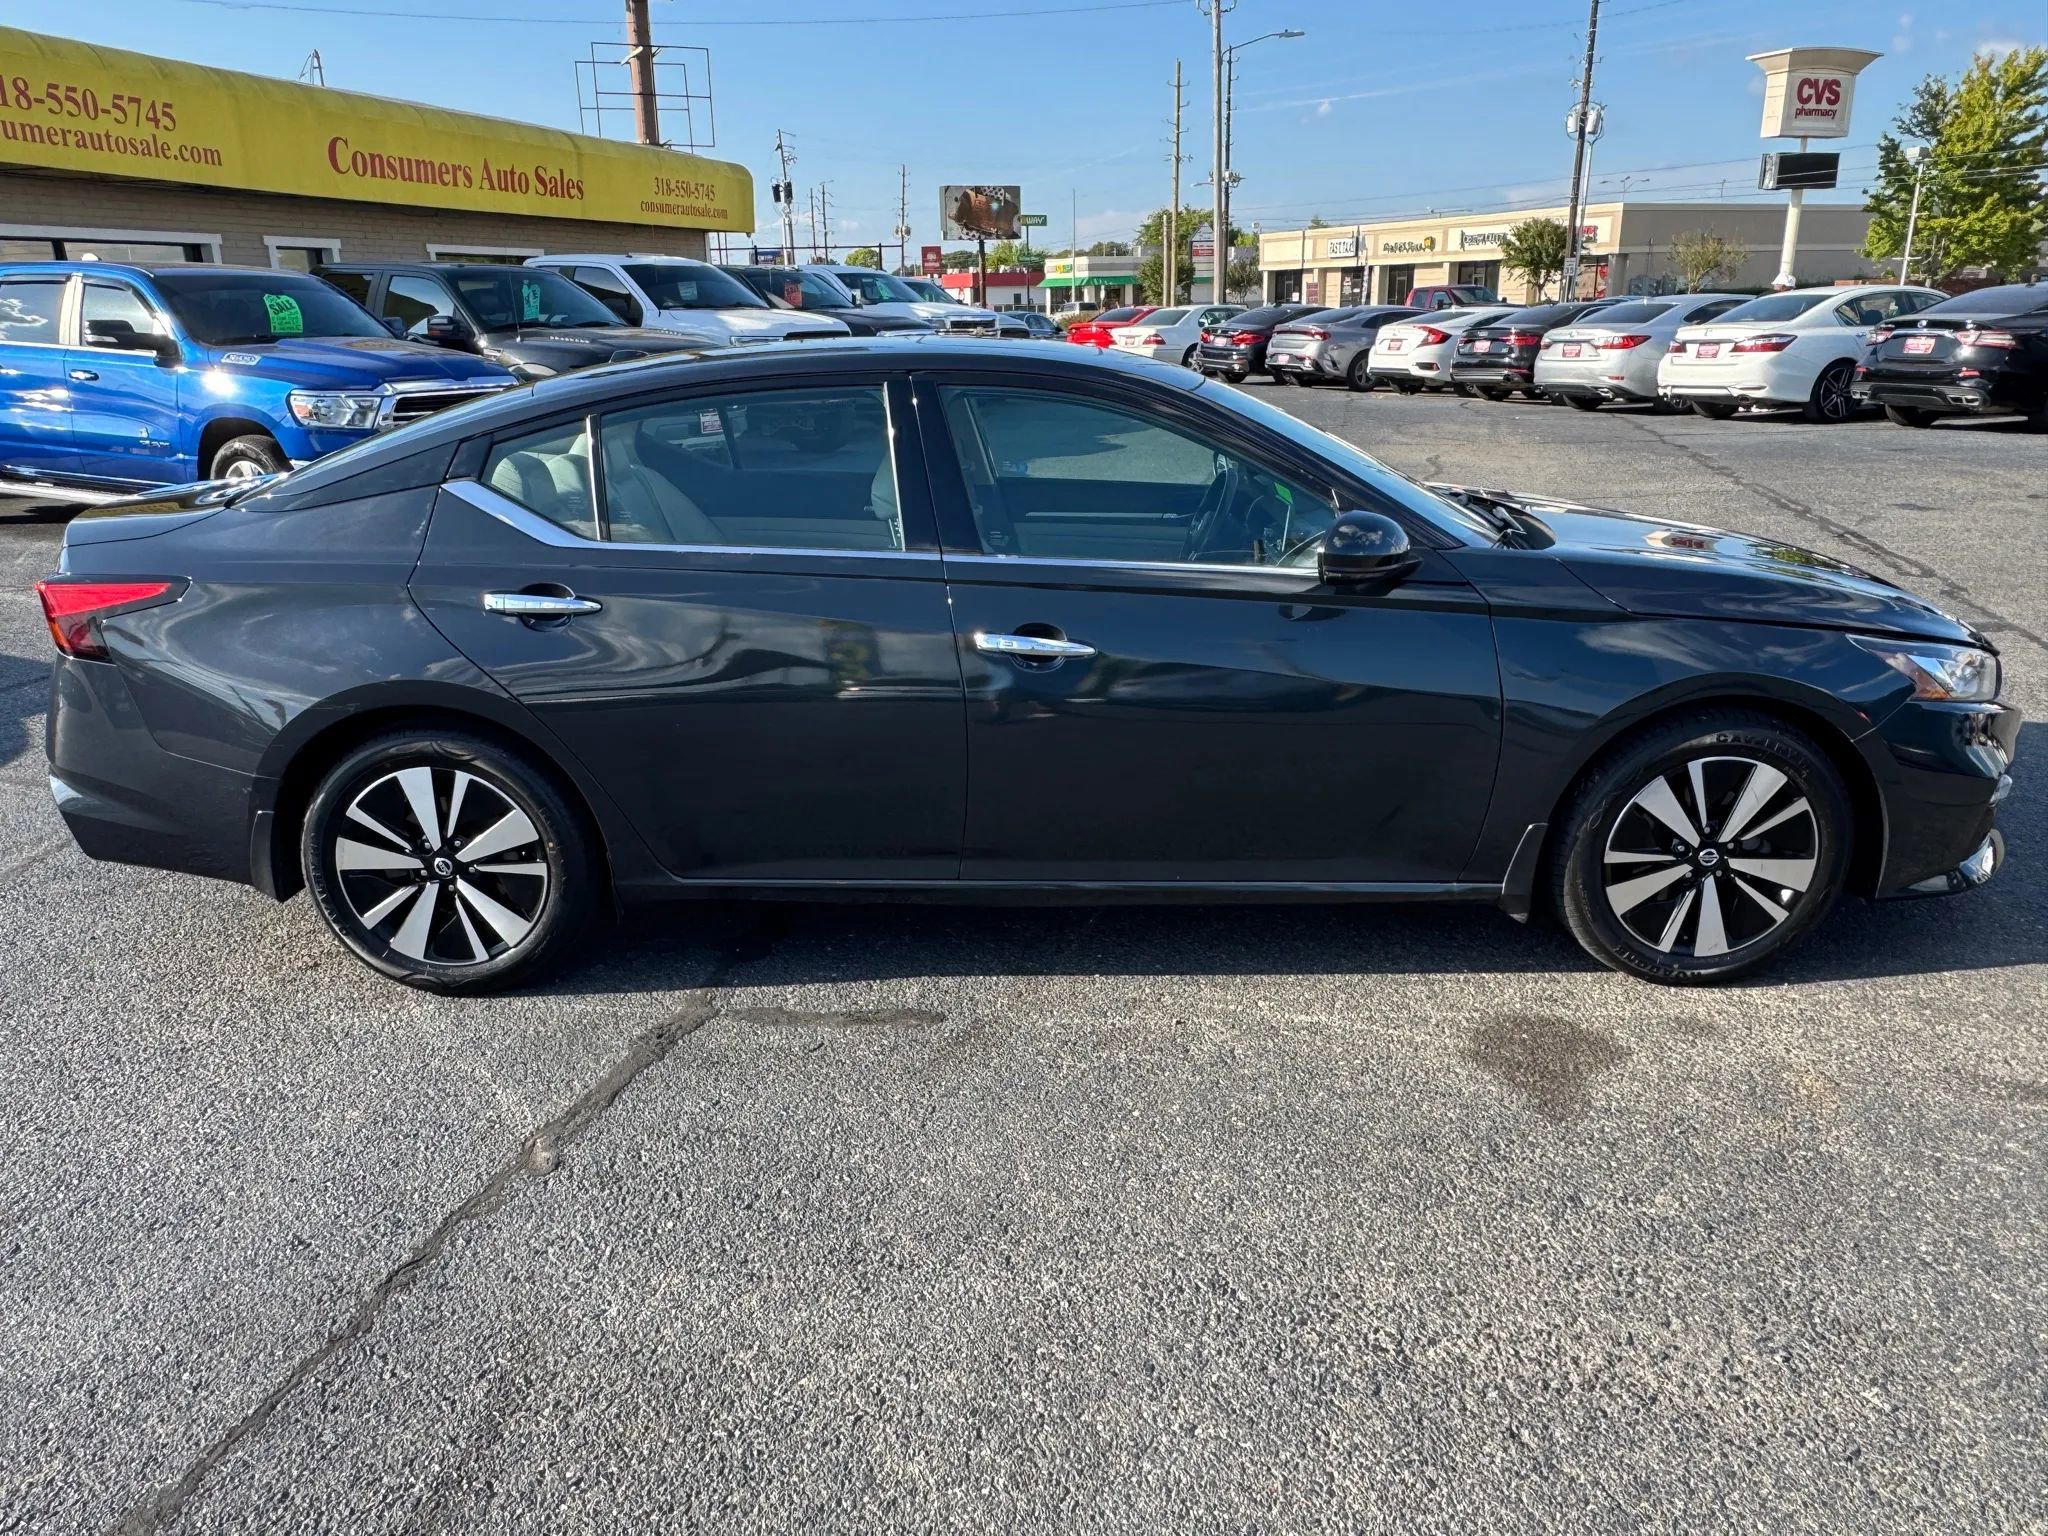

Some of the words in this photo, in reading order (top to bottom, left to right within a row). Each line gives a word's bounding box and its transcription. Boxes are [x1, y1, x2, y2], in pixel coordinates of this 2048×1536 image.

[1797, 77, 1841, 106] CVS
[1795, 105, 1837, 119] pharmacy
[328, 136, 473, 189] Consumers
[479, 157, 530, 195] Auto
[534, 165, 584, 200] Sales
[654, 176, 716, 202] 318-550-5745
[640, 200, 728, 219] consumerautosale.com
